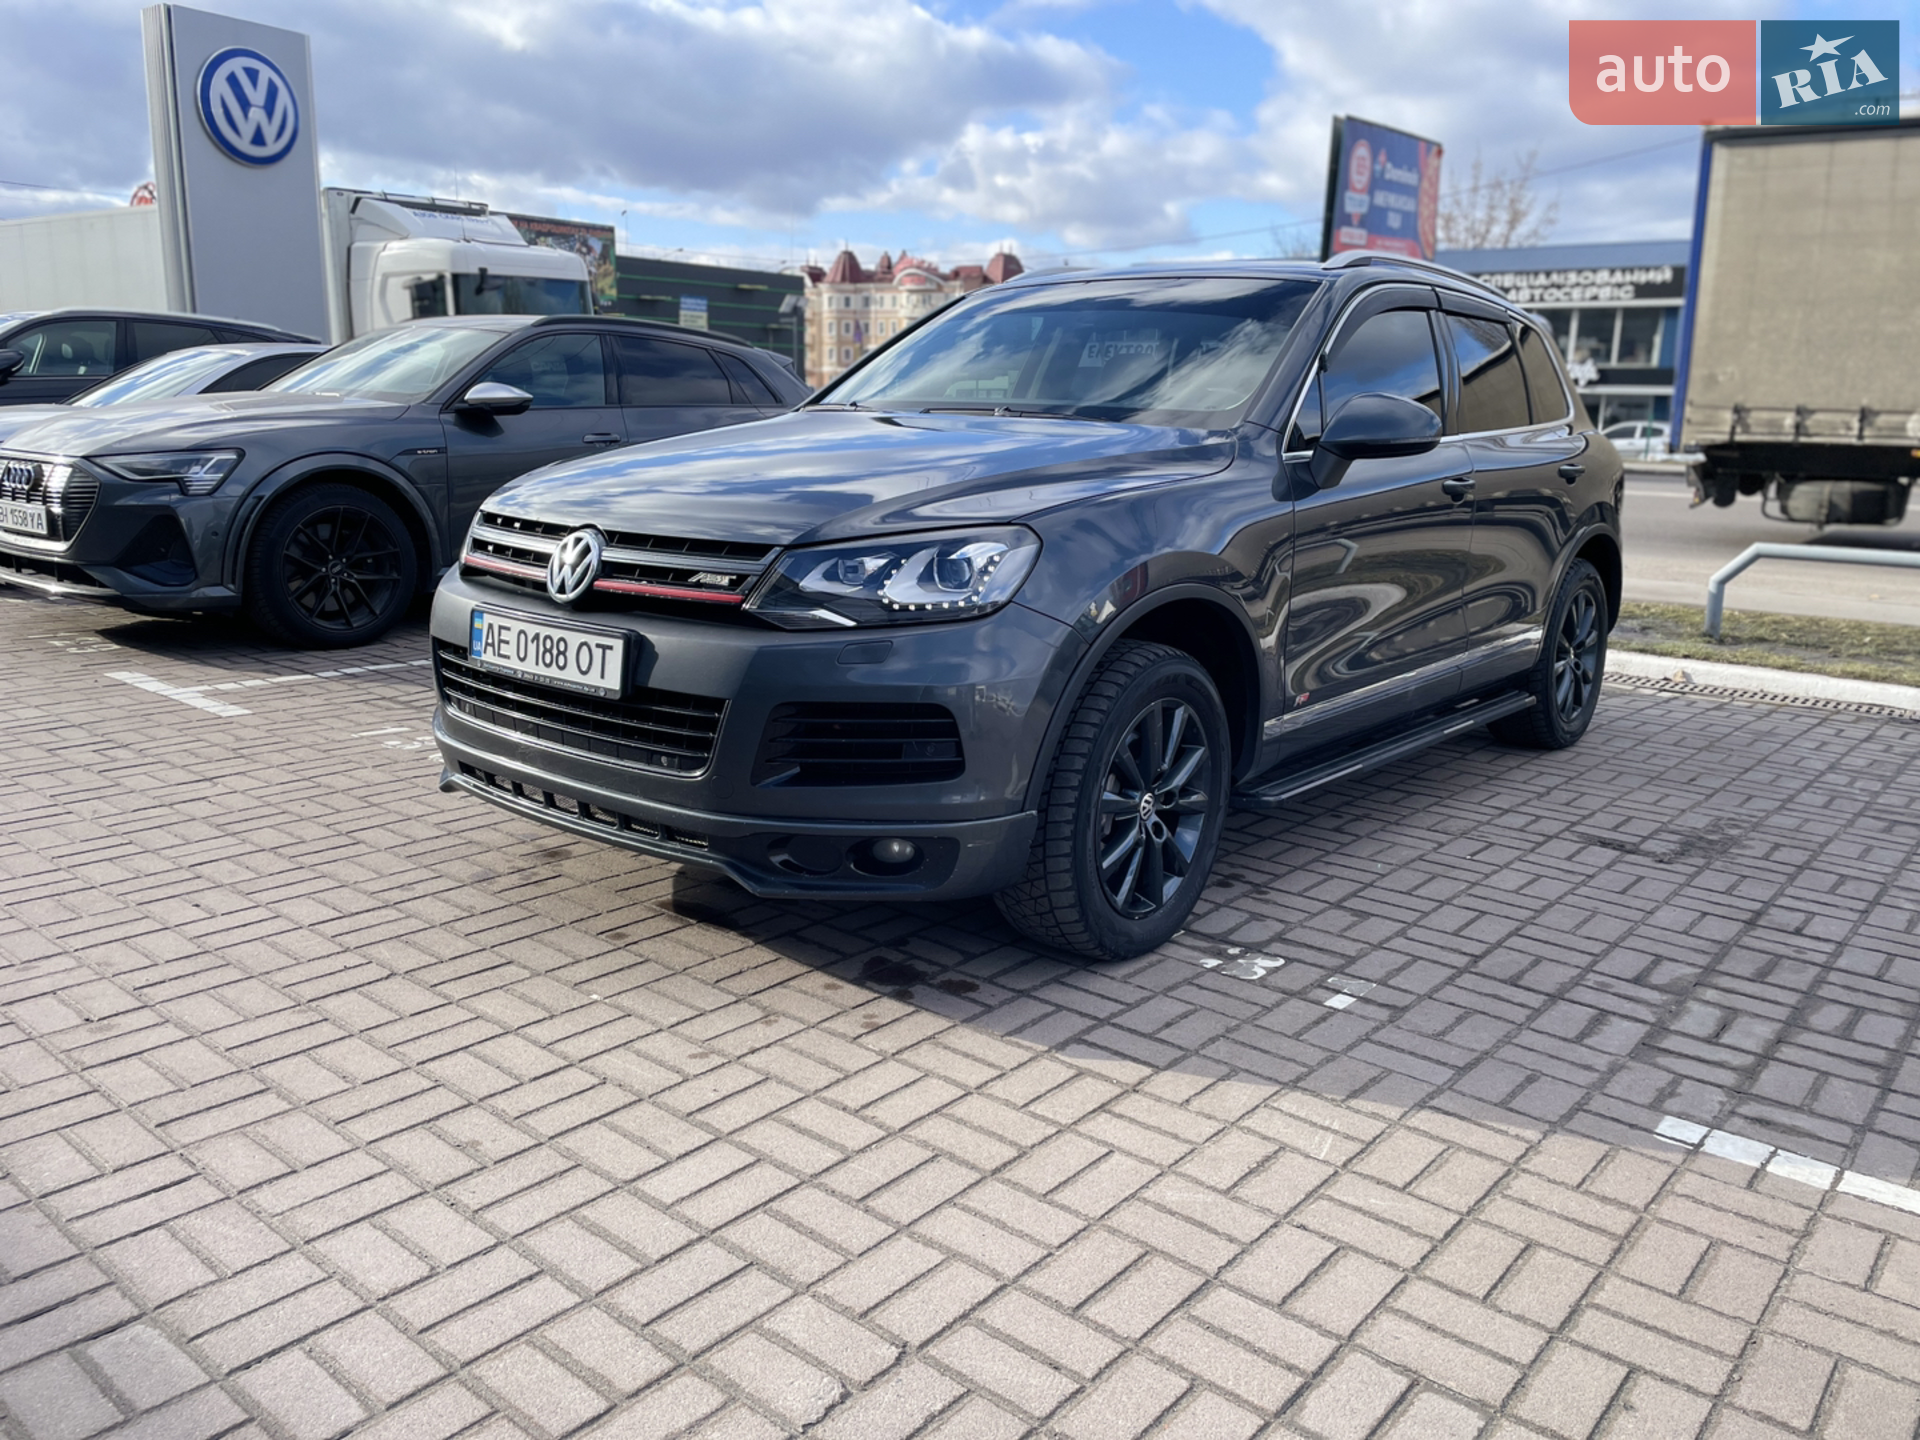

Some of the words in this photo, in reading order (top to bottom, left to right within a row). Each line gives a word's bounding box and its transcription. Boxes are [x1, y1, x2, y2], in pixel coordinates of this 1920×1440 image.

[1507, 284, 1636, 302] АВТОСЕРВІС
[483, 622, 511, 660] AE
[516, 628, 568, 671] 0188
[575, 640, 614, 680] OT
